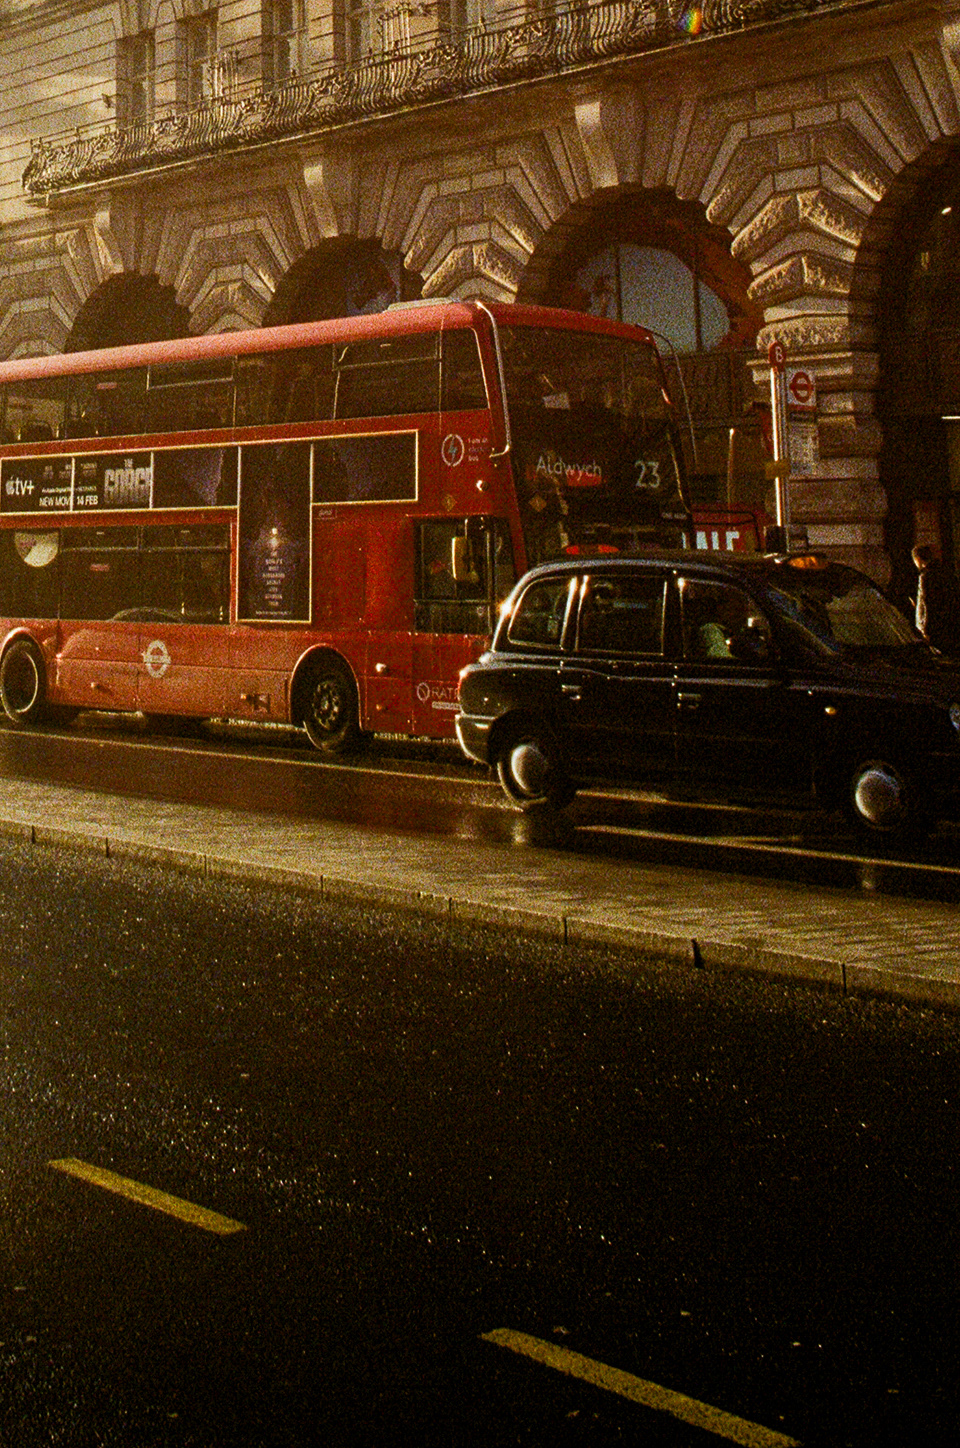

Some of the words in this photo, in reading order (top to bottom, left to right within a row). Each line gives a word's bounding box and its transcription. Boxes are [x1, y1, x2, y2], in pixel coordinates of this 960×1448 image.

[536, 454, 602, 482] Aldwych
[634, 460, 661, 488] 23
[85, 494, 99, 506] FEB
